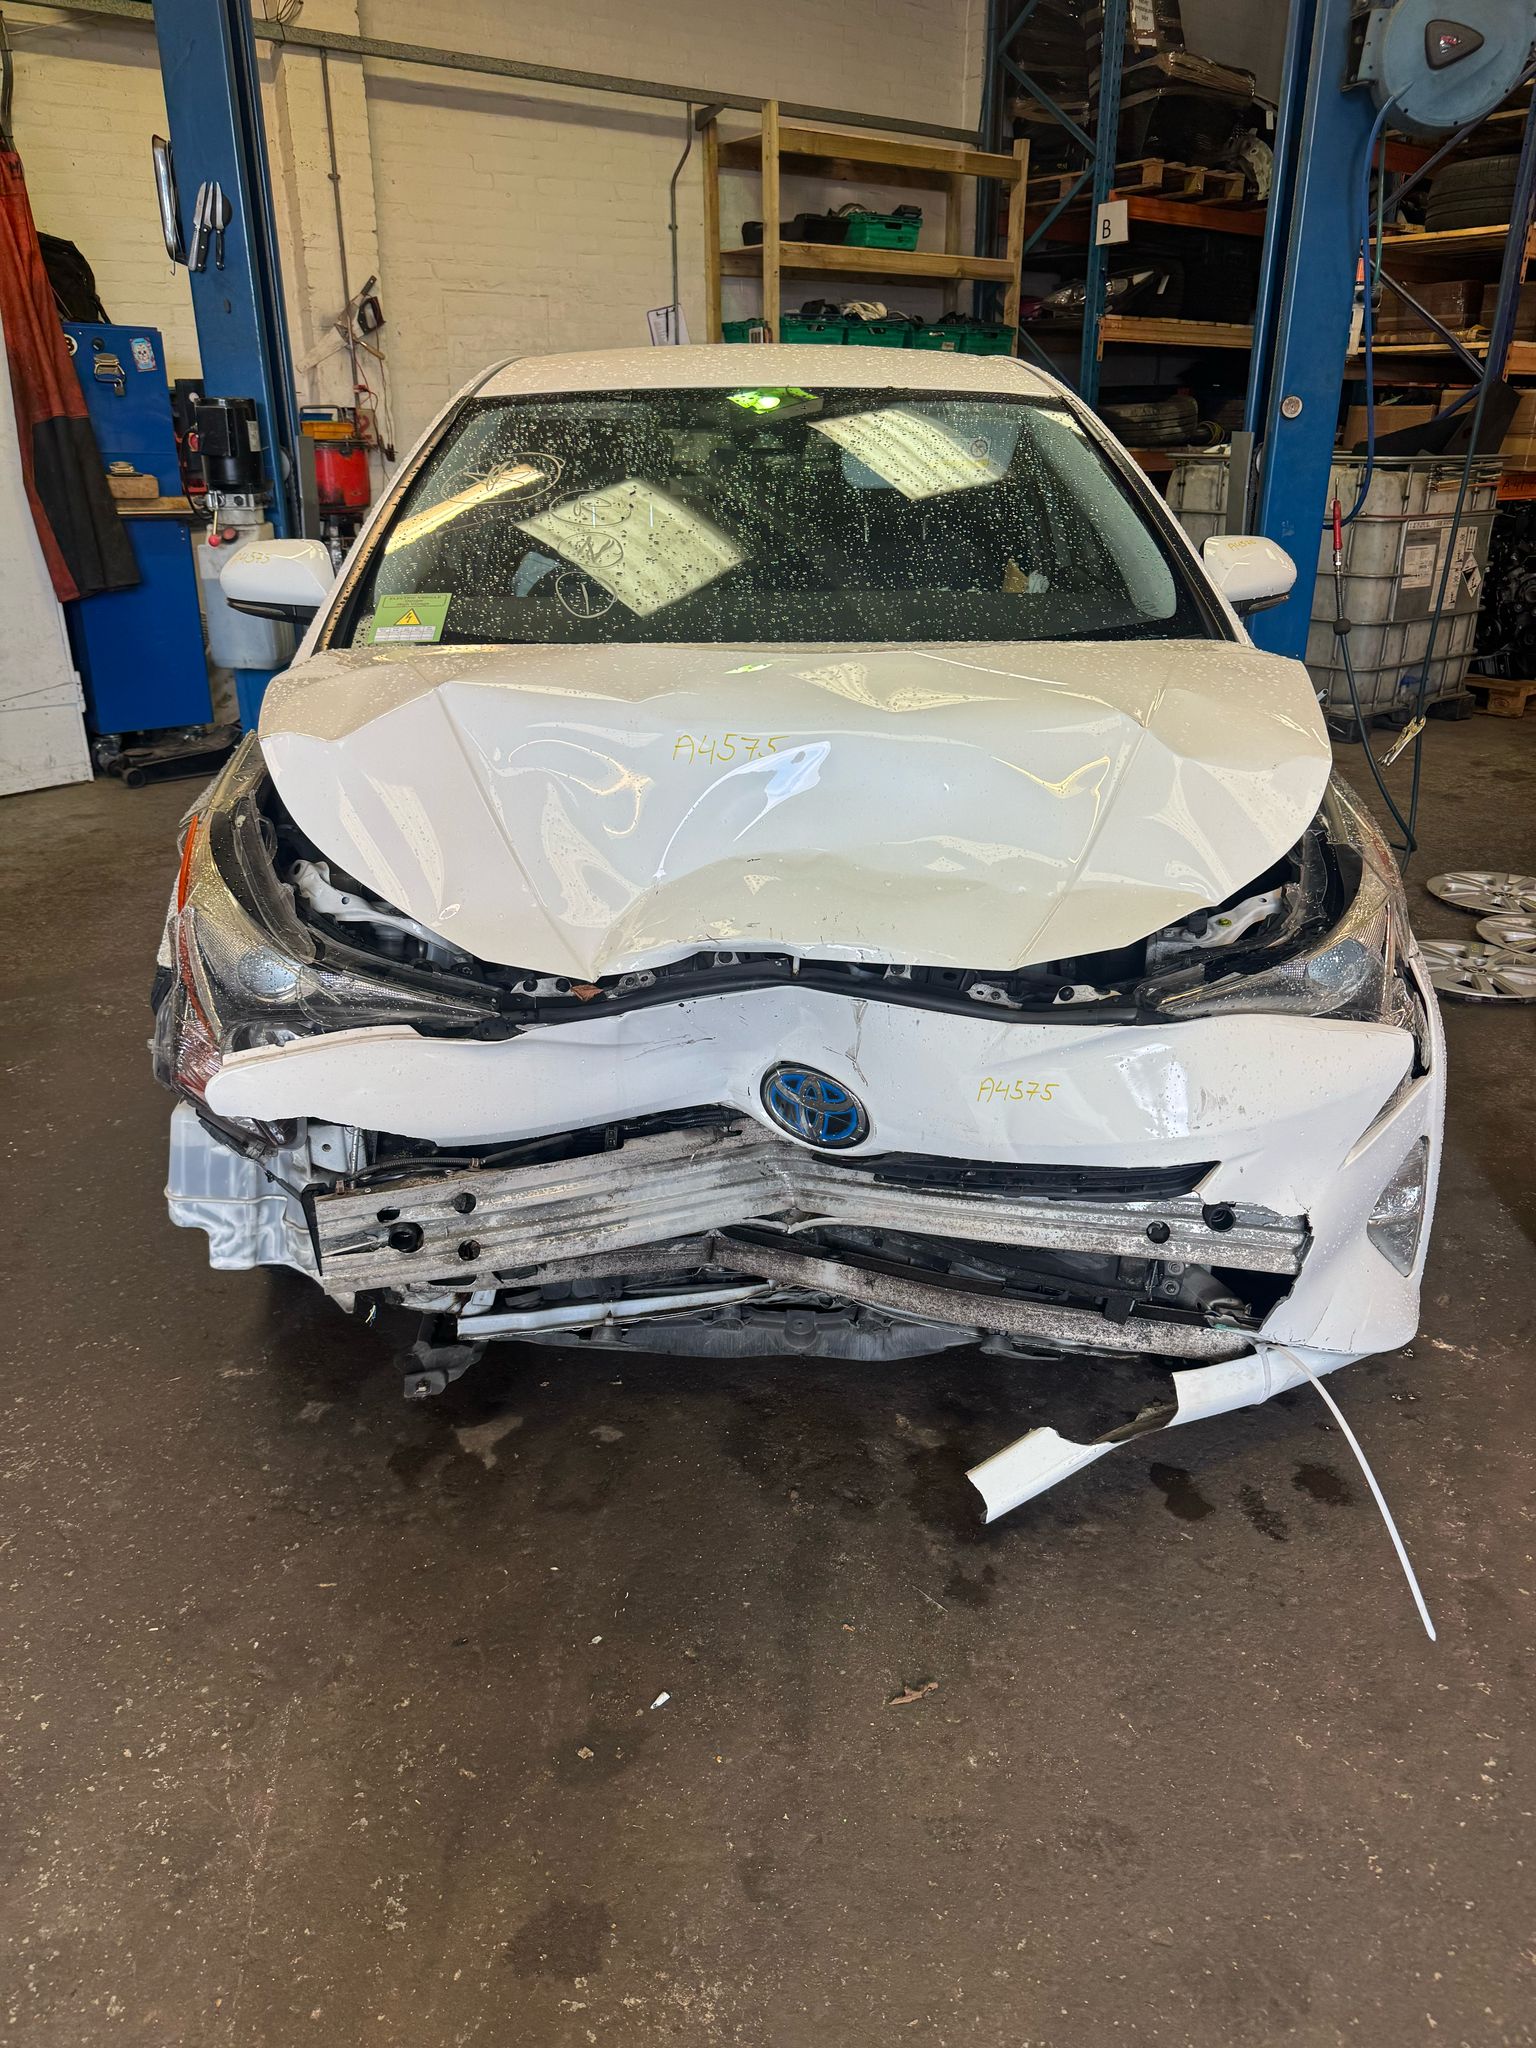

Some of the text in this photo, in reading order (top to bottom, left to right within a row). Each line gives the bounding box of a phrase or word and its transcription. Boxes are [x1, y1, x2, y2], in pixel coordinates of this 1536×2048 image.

[1102, 218, 1112, 240] B
[672, 733, 790, 766] A4575
[976, 1077, 1060, 1103] A4575
